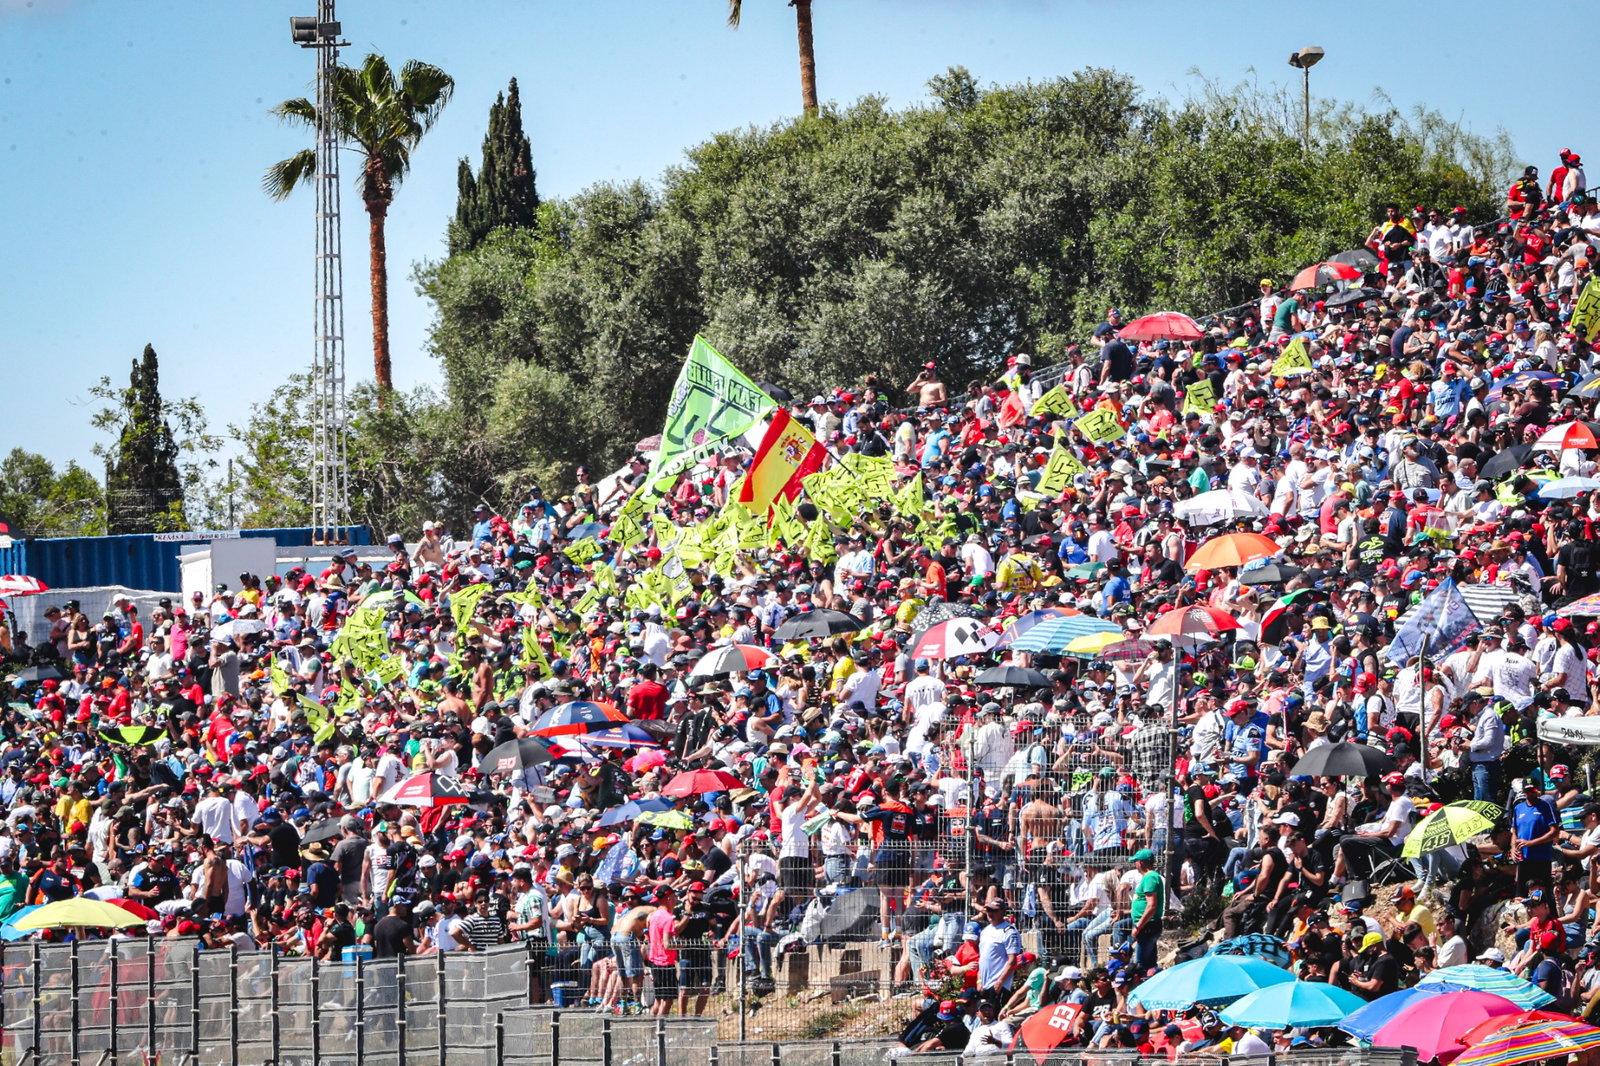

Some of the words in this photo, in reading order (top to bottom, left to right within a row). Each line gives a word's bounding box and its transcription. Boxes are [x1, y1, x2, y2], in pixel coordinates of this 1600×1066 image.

[1483, 803, 1502, 820] 46
[1455, 815, 1482, 838] 46
[1422, 831, 1450, 852] 46
[1048, 1005, 1075, 1031] 93
[1092, 1004, 1110, 1019] 26
